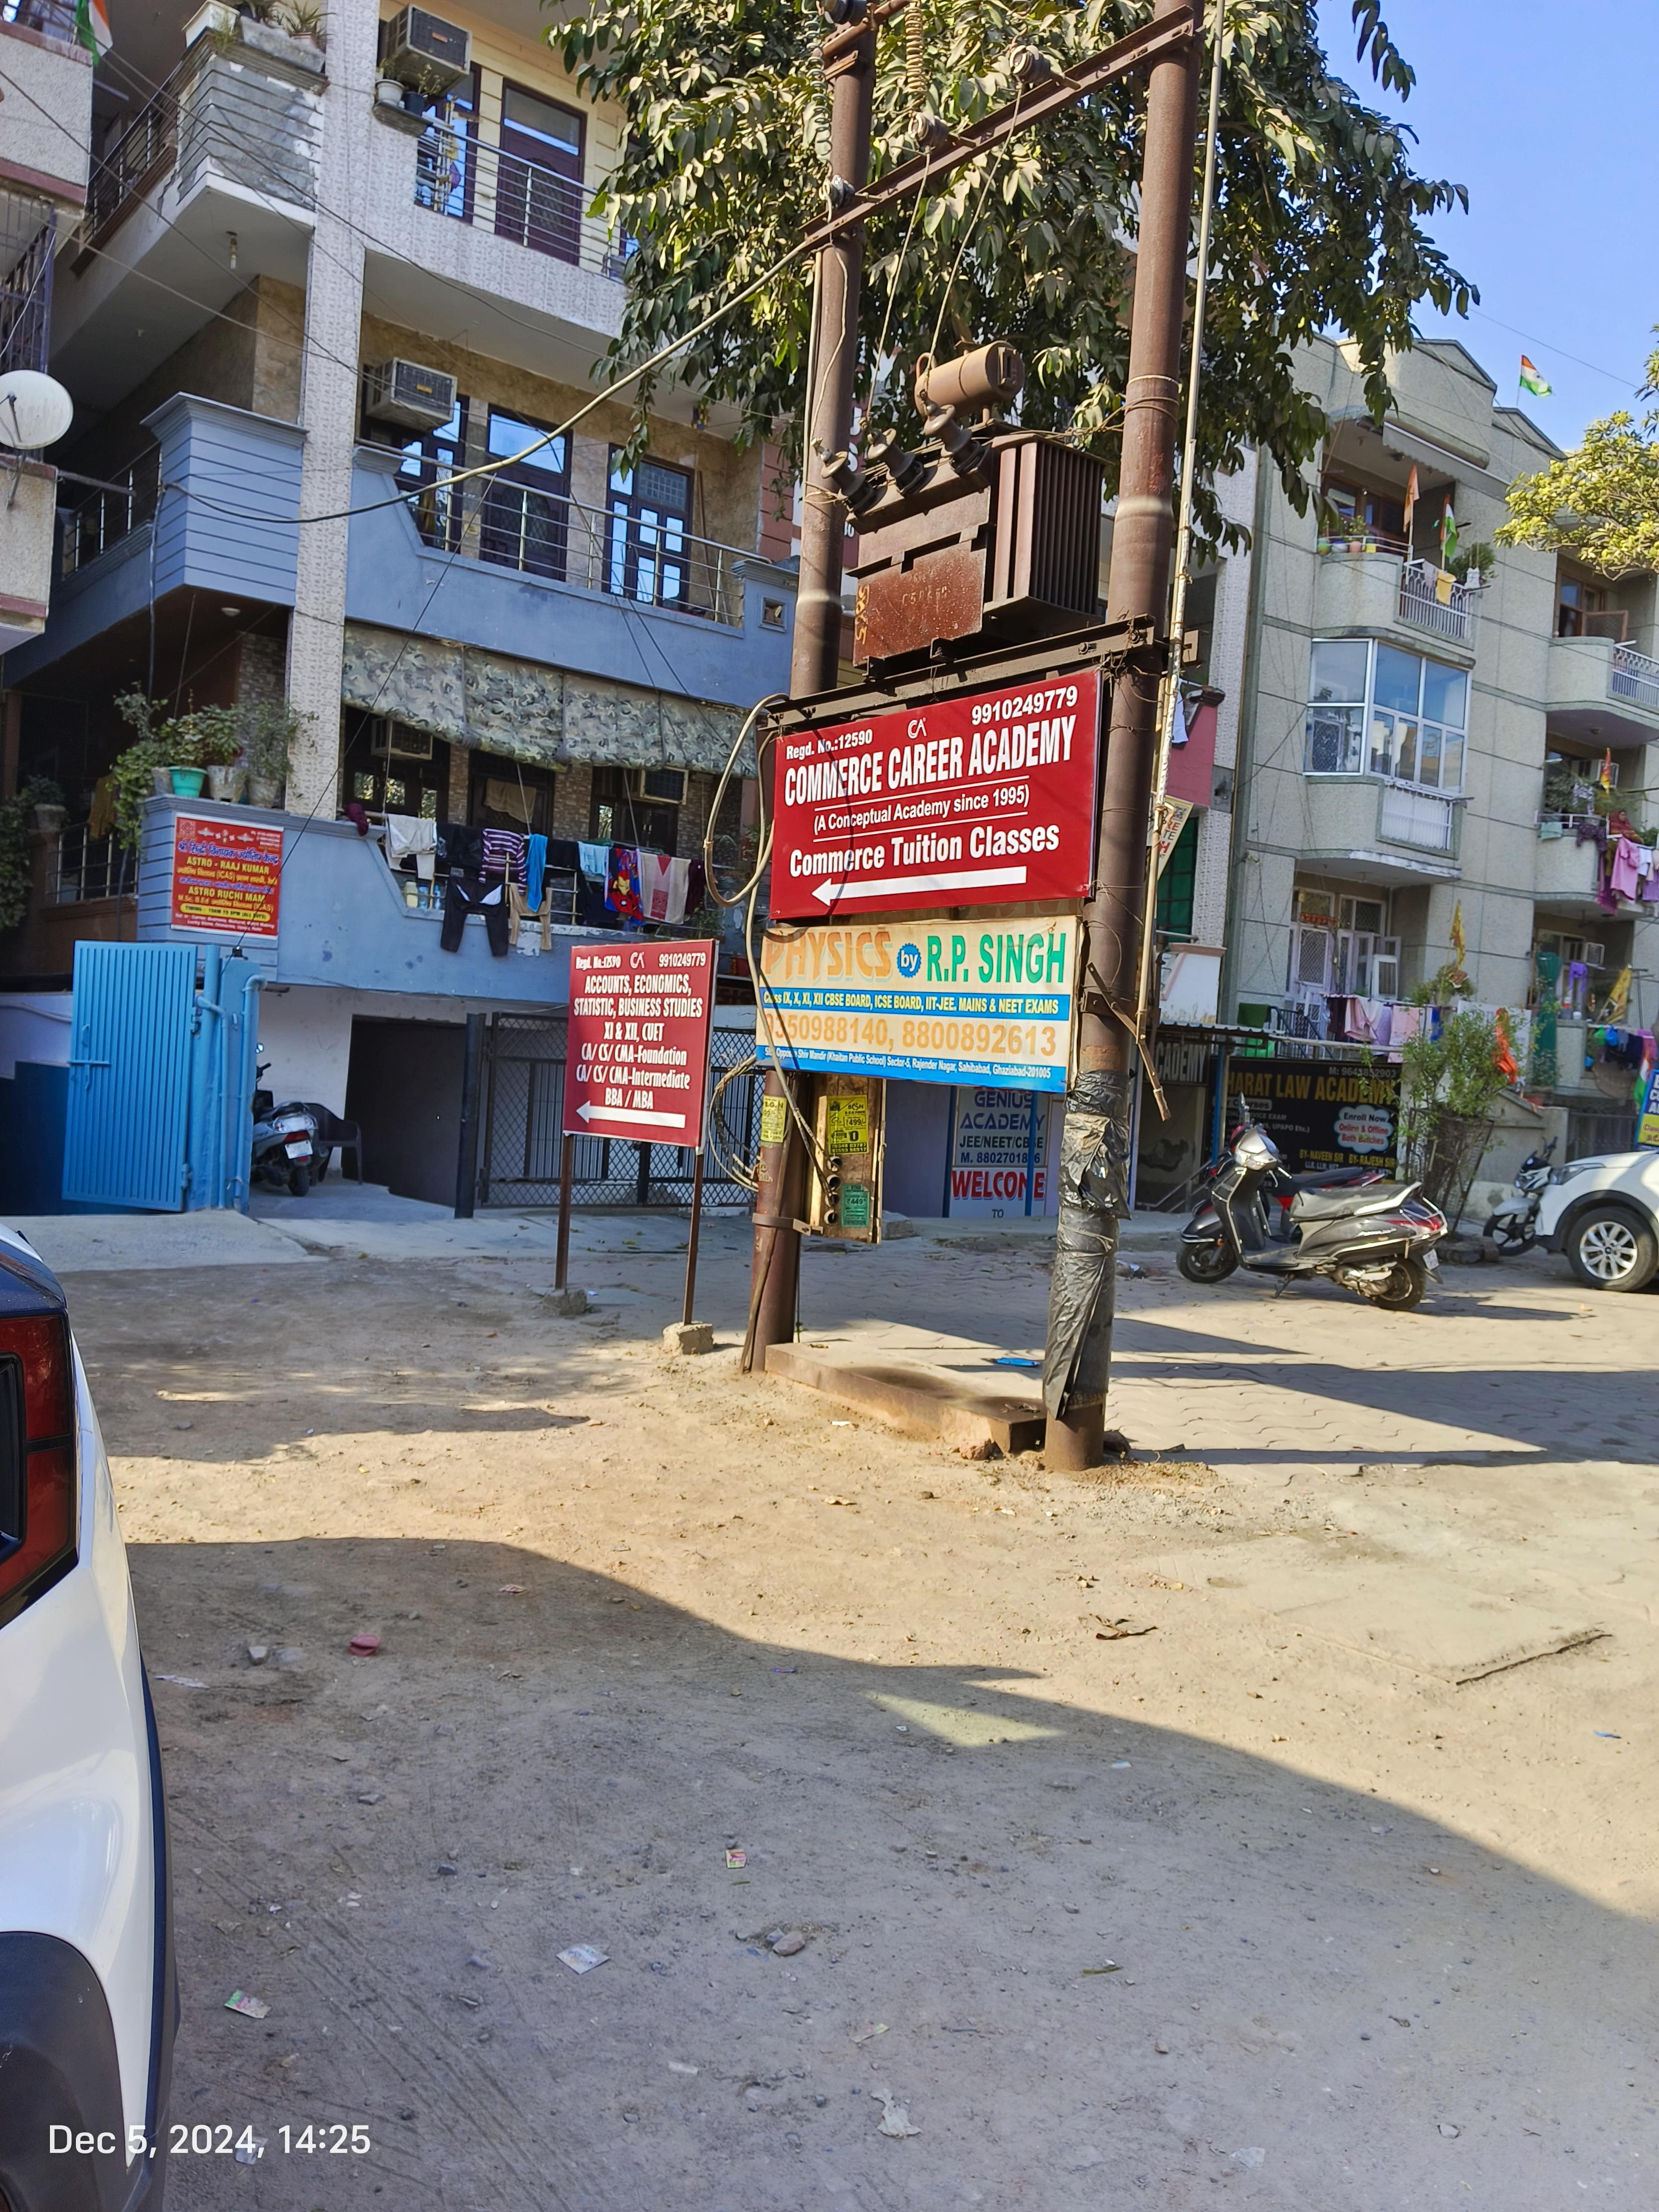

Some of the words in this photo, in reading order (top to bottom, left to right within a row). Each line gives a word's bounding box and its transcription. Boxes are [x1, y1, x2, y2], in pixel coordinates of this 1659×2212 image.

[972, 685, 1078, 726] 9910249779
[786, 742, 815, 760] Regd.
[817, 728, 873, 753] No.:12590
[784, 751, 883, 806] COMMERCE
[888, 737, 963, 790] CAREER
[968, 714, 1077, 776] ACADEMY
[814, 814, 826, 835] (A
[828, 805, 890, 833] Conceptual
[893, 795, 951, 822] Academy
[953, 793, 989, 813] since
[992, 783, 1029, 808] 1995)
[790, 845, 885, 878] Commerce
[891, 832, 962, 866] Tuition
[970, 824, 1060, 859] Classes
[187, 856, 212, 867] ASTRO
[220, 860, 240, 871] RAAJ
[242, 863, 269, 875] KUMAR
[188, 886, 215, 897] ASTRO
[217, 890, 243, 901] RUCHI
[659, 952, 706, 967] 9910249779
[764, 931, 892, 984] PHYSICS
[900, 951, 918, 971] by
[927, 935, 969, 982] R.P.
[979, 933, 1066, 983] SINGH
[585, 975, 632, 996] ACCOUNTS,
[634, 974, 691, 996] ECONOMICS,
[574, 998, 616, 1019] STATISTIC,
[618, 998, 661, 1017] BUSINESS
[663, 998, 702, 1018] STUDIES
[783, 992, 793, 1007] IX,
[793, 992, 801, 1007] X,
[802, 992, 812, 1008] XI,
[825, 994, 844, 1006] CBSE
[845, 996, 873, 1010] BOARD,
[875, 996, 892, 1010] ICSE
[894, 997, 924, 1012] BOARD,
[959, 998, 987, 1013] MAINS
[989, 1000, 996, 1013] &
[998, 999, 1023, 1014] NEET
[1025, 999, 1058, 1014] EXAMS
[603, 1022, 613, 1039] XI
[615, 1022, 623, 1039] &
[625, 1022, 639, 1042] XII,
[642, 1022, 664, 1041] CUET
[902, 1020, 1056, 1057] 8800892613
[581, 1043, 598, 1061] CA/
[599, 1044, 613, 1062] CS/
[614, 1045, 687, 1066] CMA-Foundation
[912, 1058, 938, 1070] Rajender
[576, 1064, 590, 1082] CA/
[593, 1065, 608, 1083] CS/
[609, 1066, 690, 1090] CMA-Intermediate
[1275, 1074, 1311, 1100] LAW
[605, 1088, 623, 1106] BBA
[625, 1090, 632, 1107] /
[633, 1091, 653, 1109] MBA
[1344, 1113, 1366, 1121] Enroll
[1368, 1115, 1386, 1123] Now
[960, 1136, 1044, 1148] JEE/NEET/CBE
[961, 1153, 973, 1164] M.
[976, 1153, 1040, 1164] 880270186
[1310, 1150, 1333, 1161] NAVEEN
[1334, 1153, 1344, 1163] SIR
[1359, 1154, 1383, 1166] RAJESH
[992, 1209, 1004, 1218] TO
